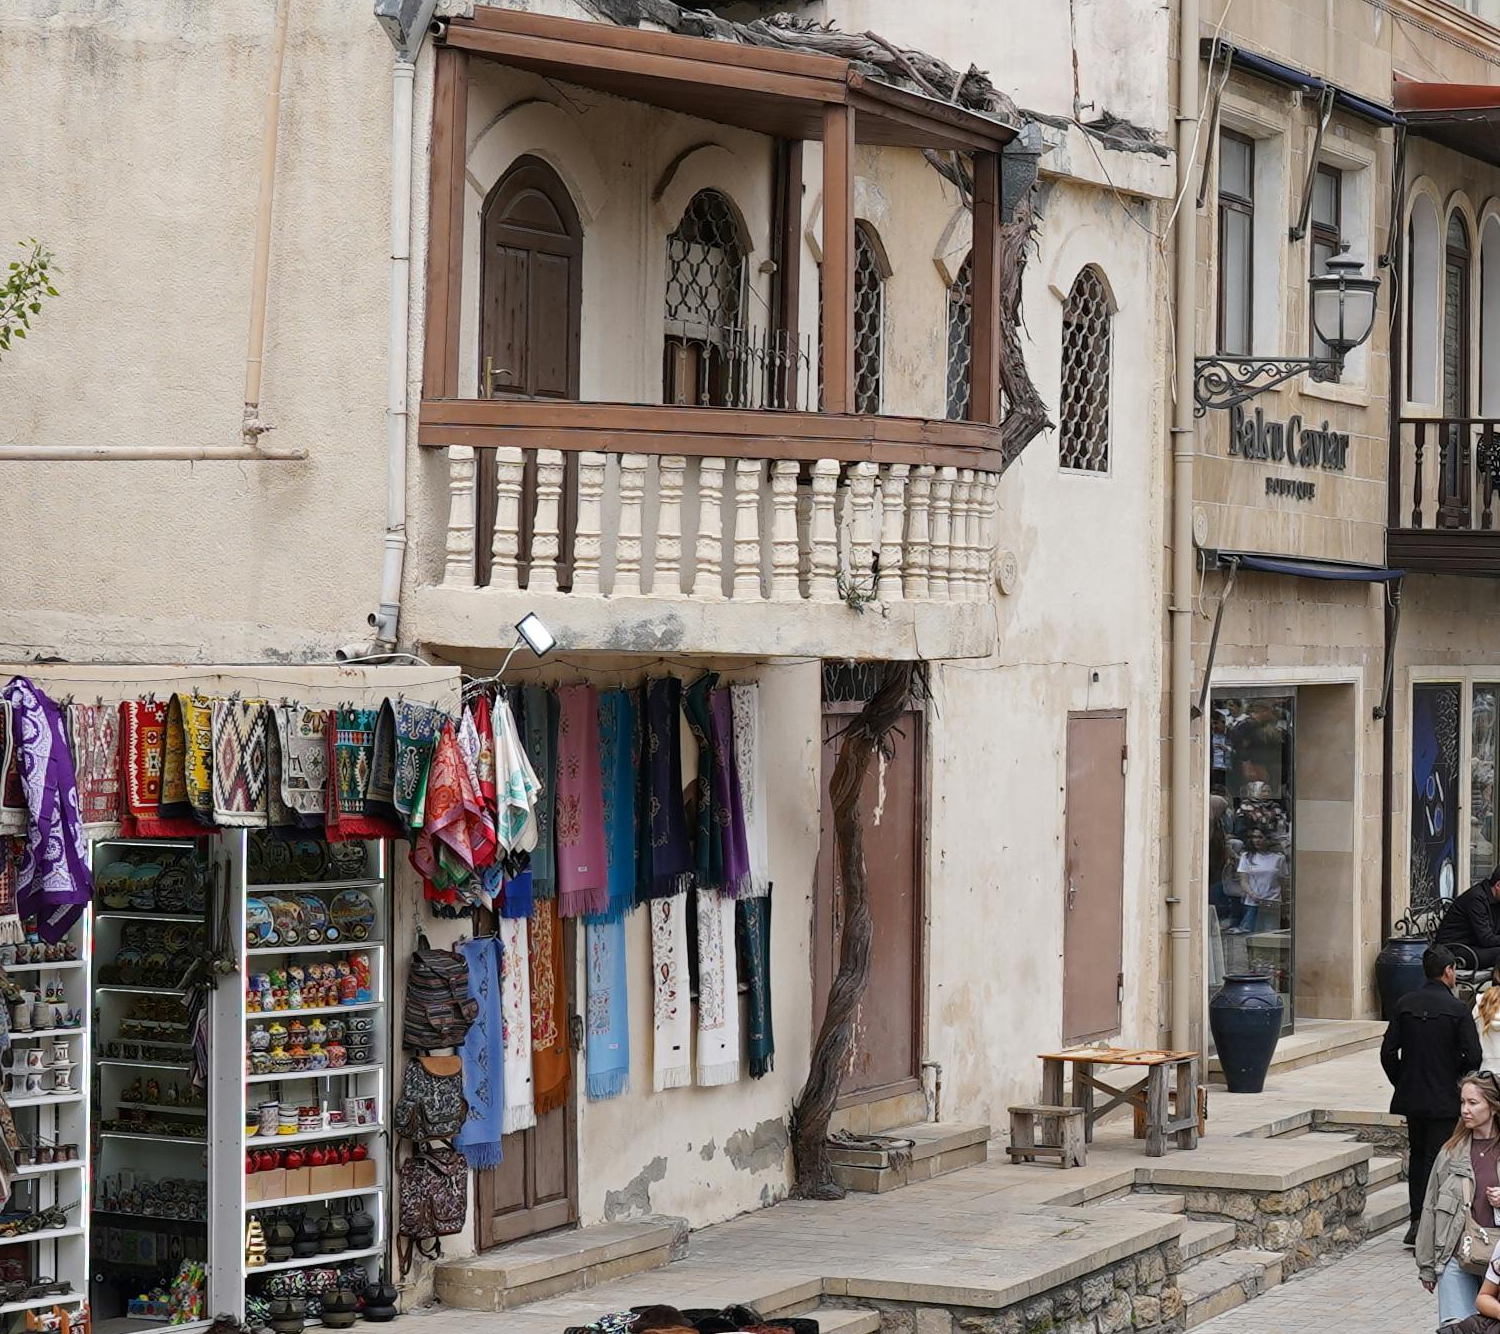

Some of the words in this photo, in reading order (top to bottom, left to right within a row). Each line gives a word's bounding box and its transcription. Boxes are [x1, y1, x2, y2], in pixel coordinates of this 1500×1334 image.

[1227, 404, 1285, 461] Baku
[1286, 415, 1349, 470] Caviar
[1265, 477, 1315, 500] BOUTIQUE
